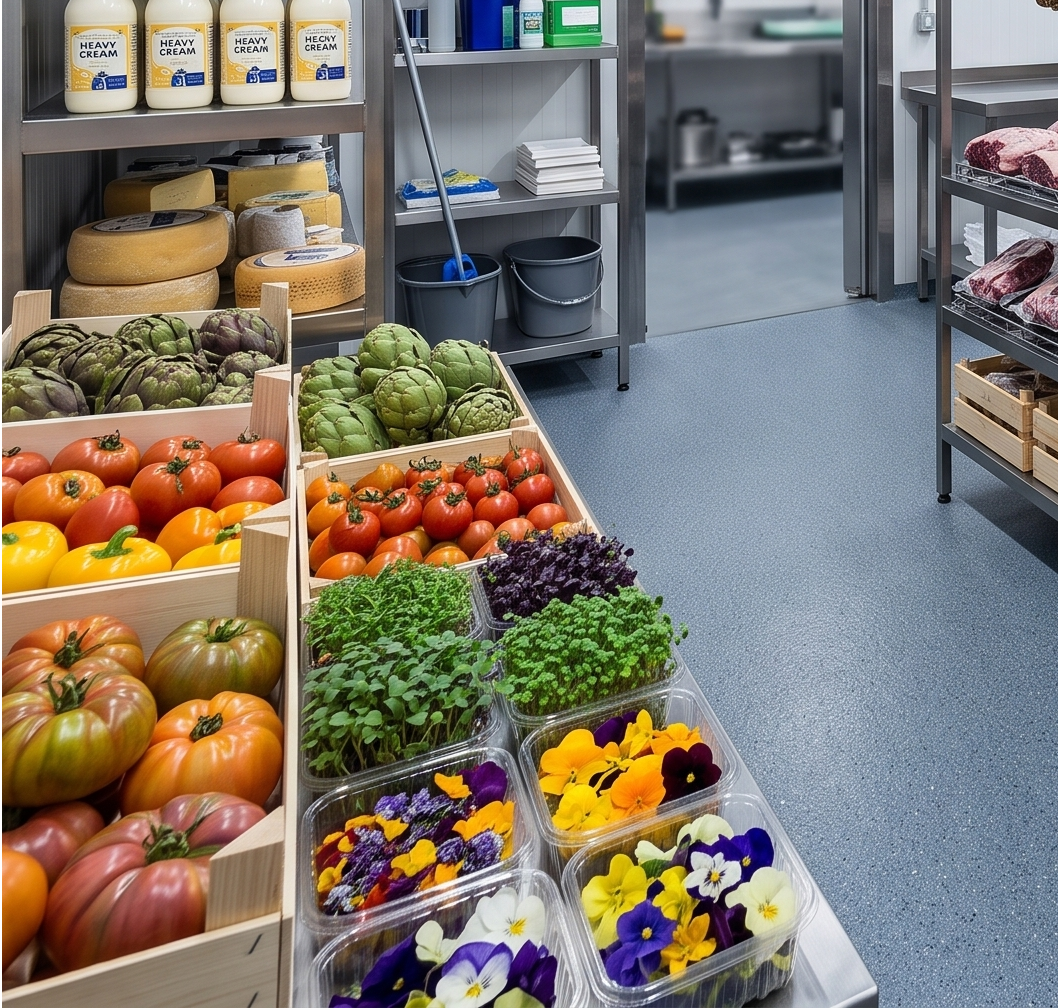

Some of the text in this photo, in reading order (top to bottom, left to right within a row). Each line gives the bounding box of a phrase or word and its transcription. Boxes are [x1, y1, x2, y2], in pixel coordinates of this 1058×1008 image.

[160, 39, 195, 47] HEAVY
[235, 37, 268, 45] HEAVY
[80, 41, 116, 50] HEAVY
[304, 43, 338, 52] CREAM
[79, 50, 118, 58] CREAM
[159, 47, 196, 56] CREAM
